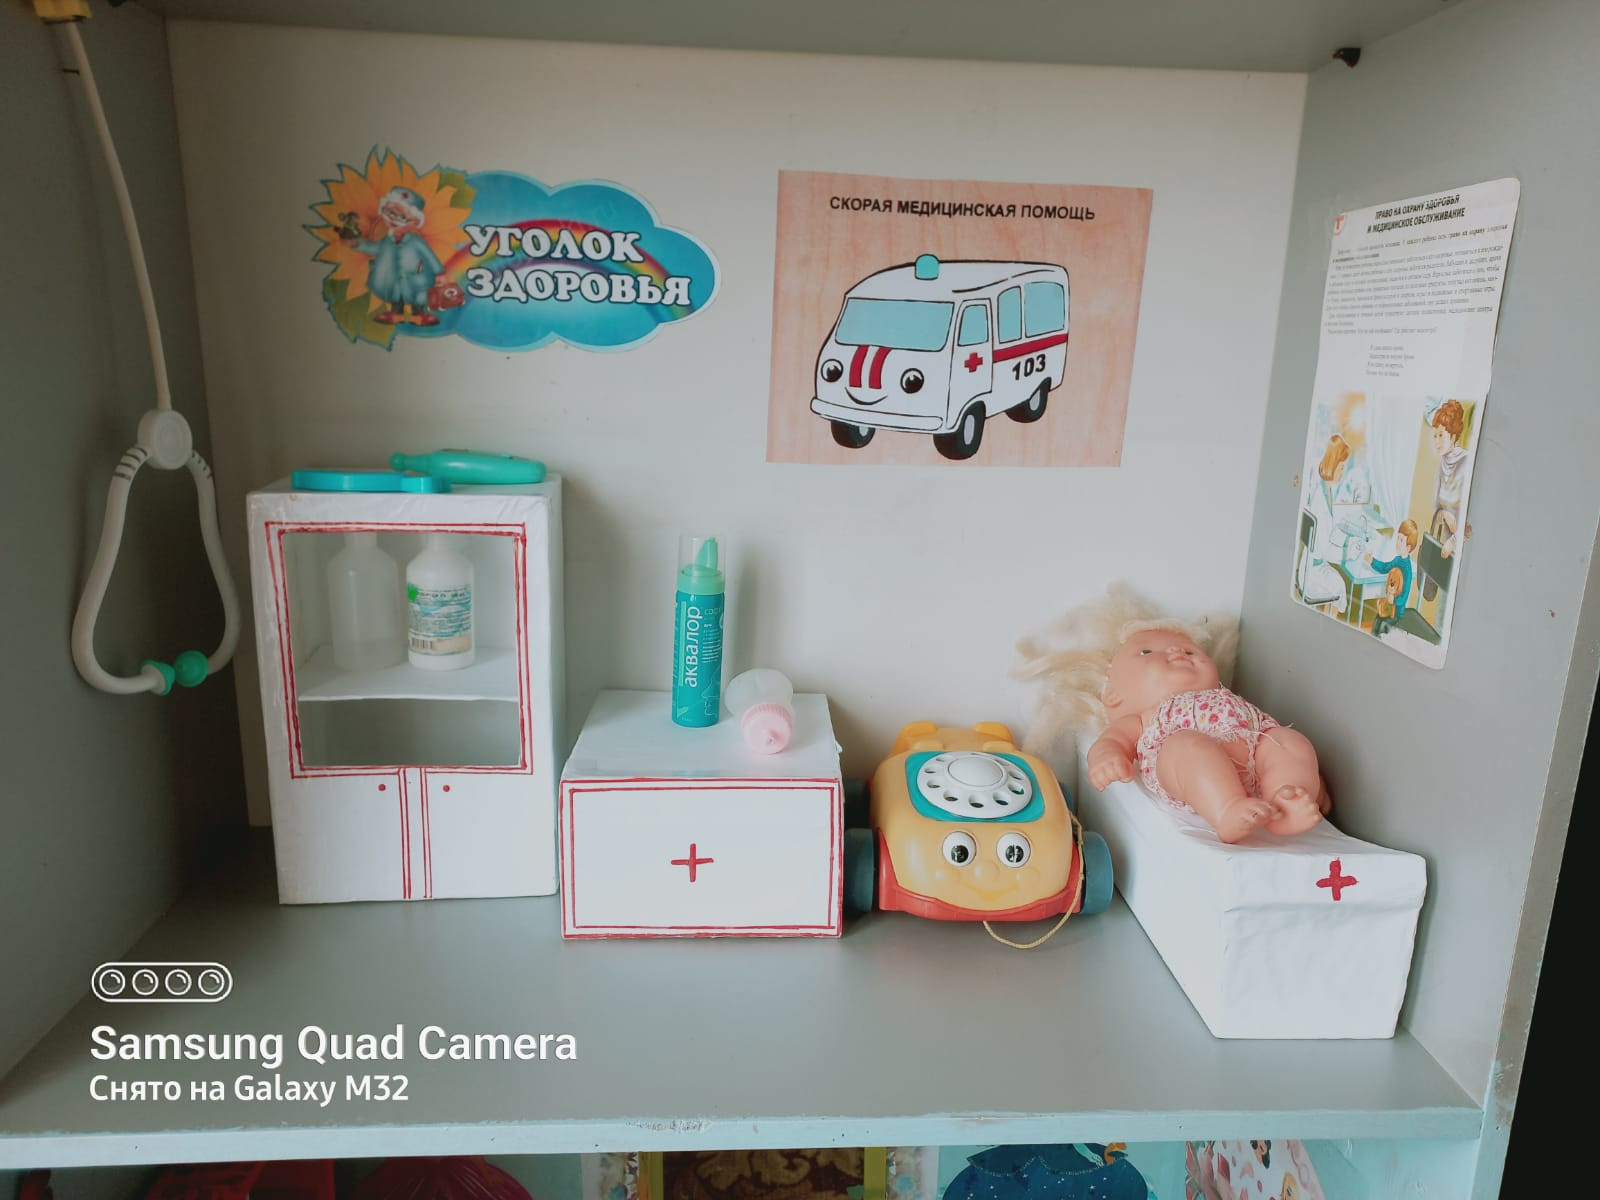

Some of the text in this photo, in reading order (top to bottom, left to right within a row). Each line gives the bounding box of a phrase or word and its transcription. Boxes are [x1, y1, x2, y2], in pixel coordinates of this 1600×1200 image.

[829, 196, 1096, 221] СКОРАЯ МЕДИЦИНСКАЯ ПОМОЩЬ
[1372, 217, 1414, 233] МЕДИЦИНСКОЕ
[1414, 207, 1466, 225] ОБСЛУЖИВАНИЕ
[1375, 194, 1461, 220] ПРАВО НА ОХРАНУ ЗДОРОВЬЯ
[463, 224, 645, 263] УГОЛОК
[466, 268, 693, 306] ЗДОРОВЬЯ
[1011, 354, 1047, 381] 103
[684, 605, 703, 688] аквалор
